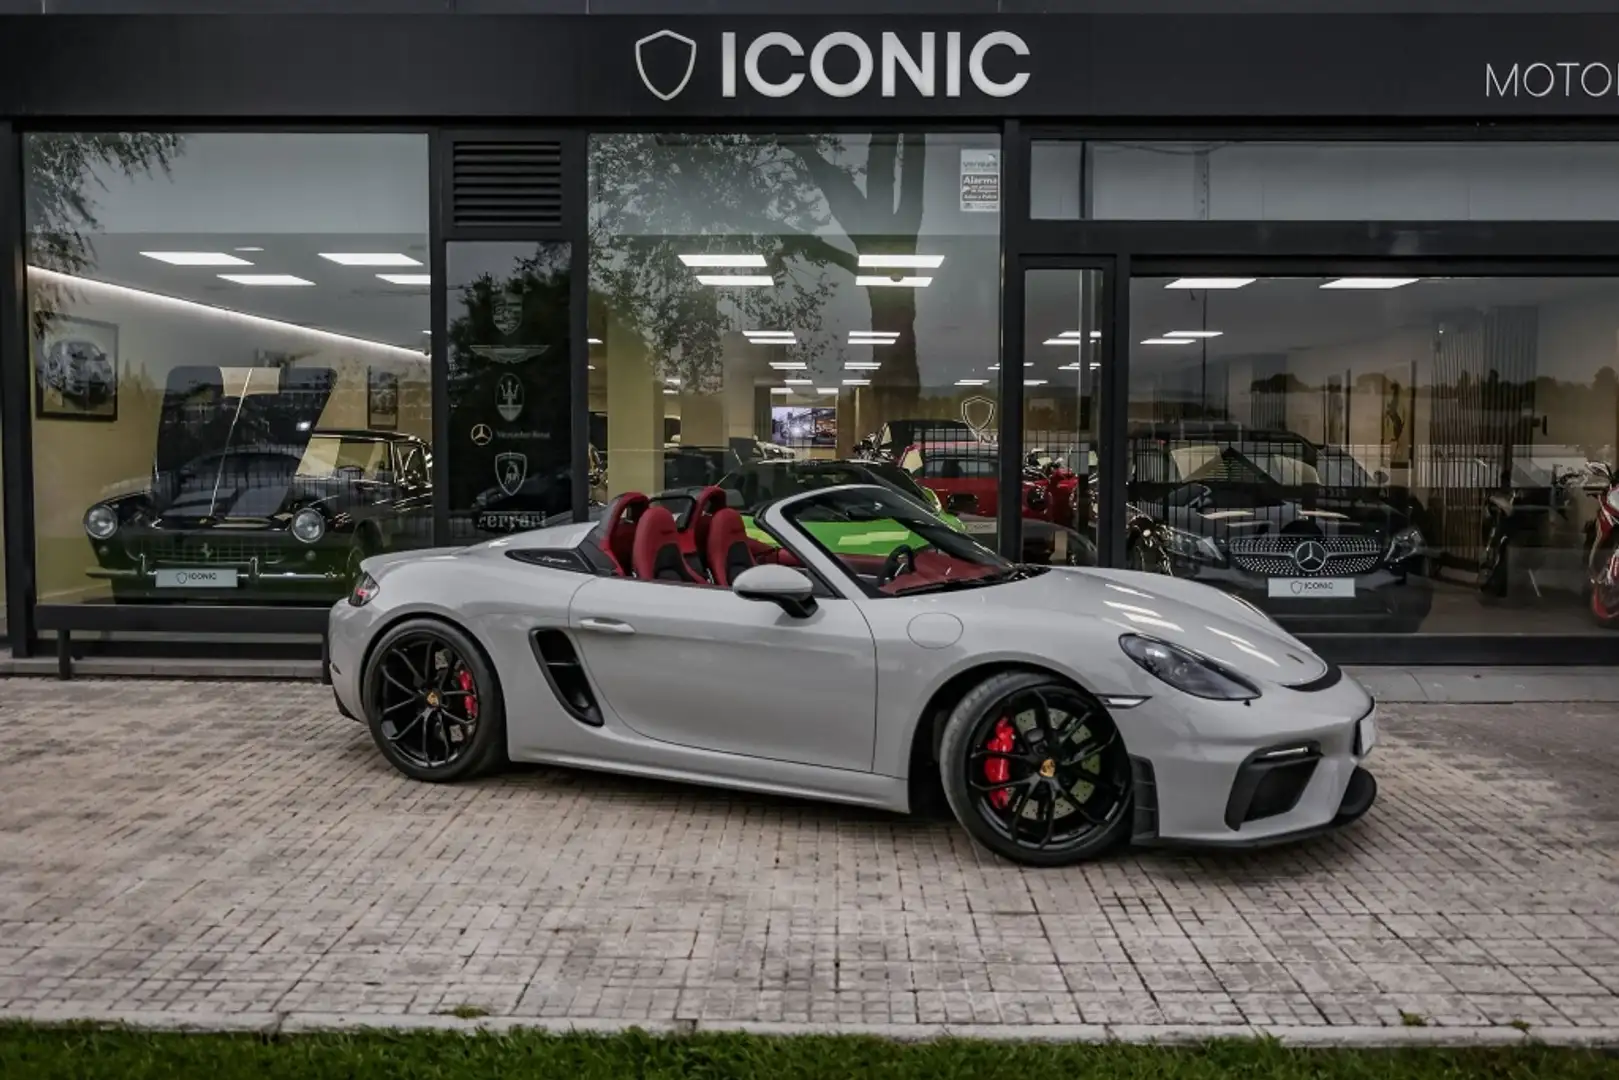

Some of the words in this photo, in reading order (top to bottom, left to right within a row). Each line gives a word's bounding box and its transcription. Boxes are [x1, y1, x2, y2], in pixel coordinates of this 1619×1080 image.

[722, 31, 1031, 97] ICONIC
[1486, 62, 1619, 97] MOTO
[1304, 581, 1333, 589] ICONIC
